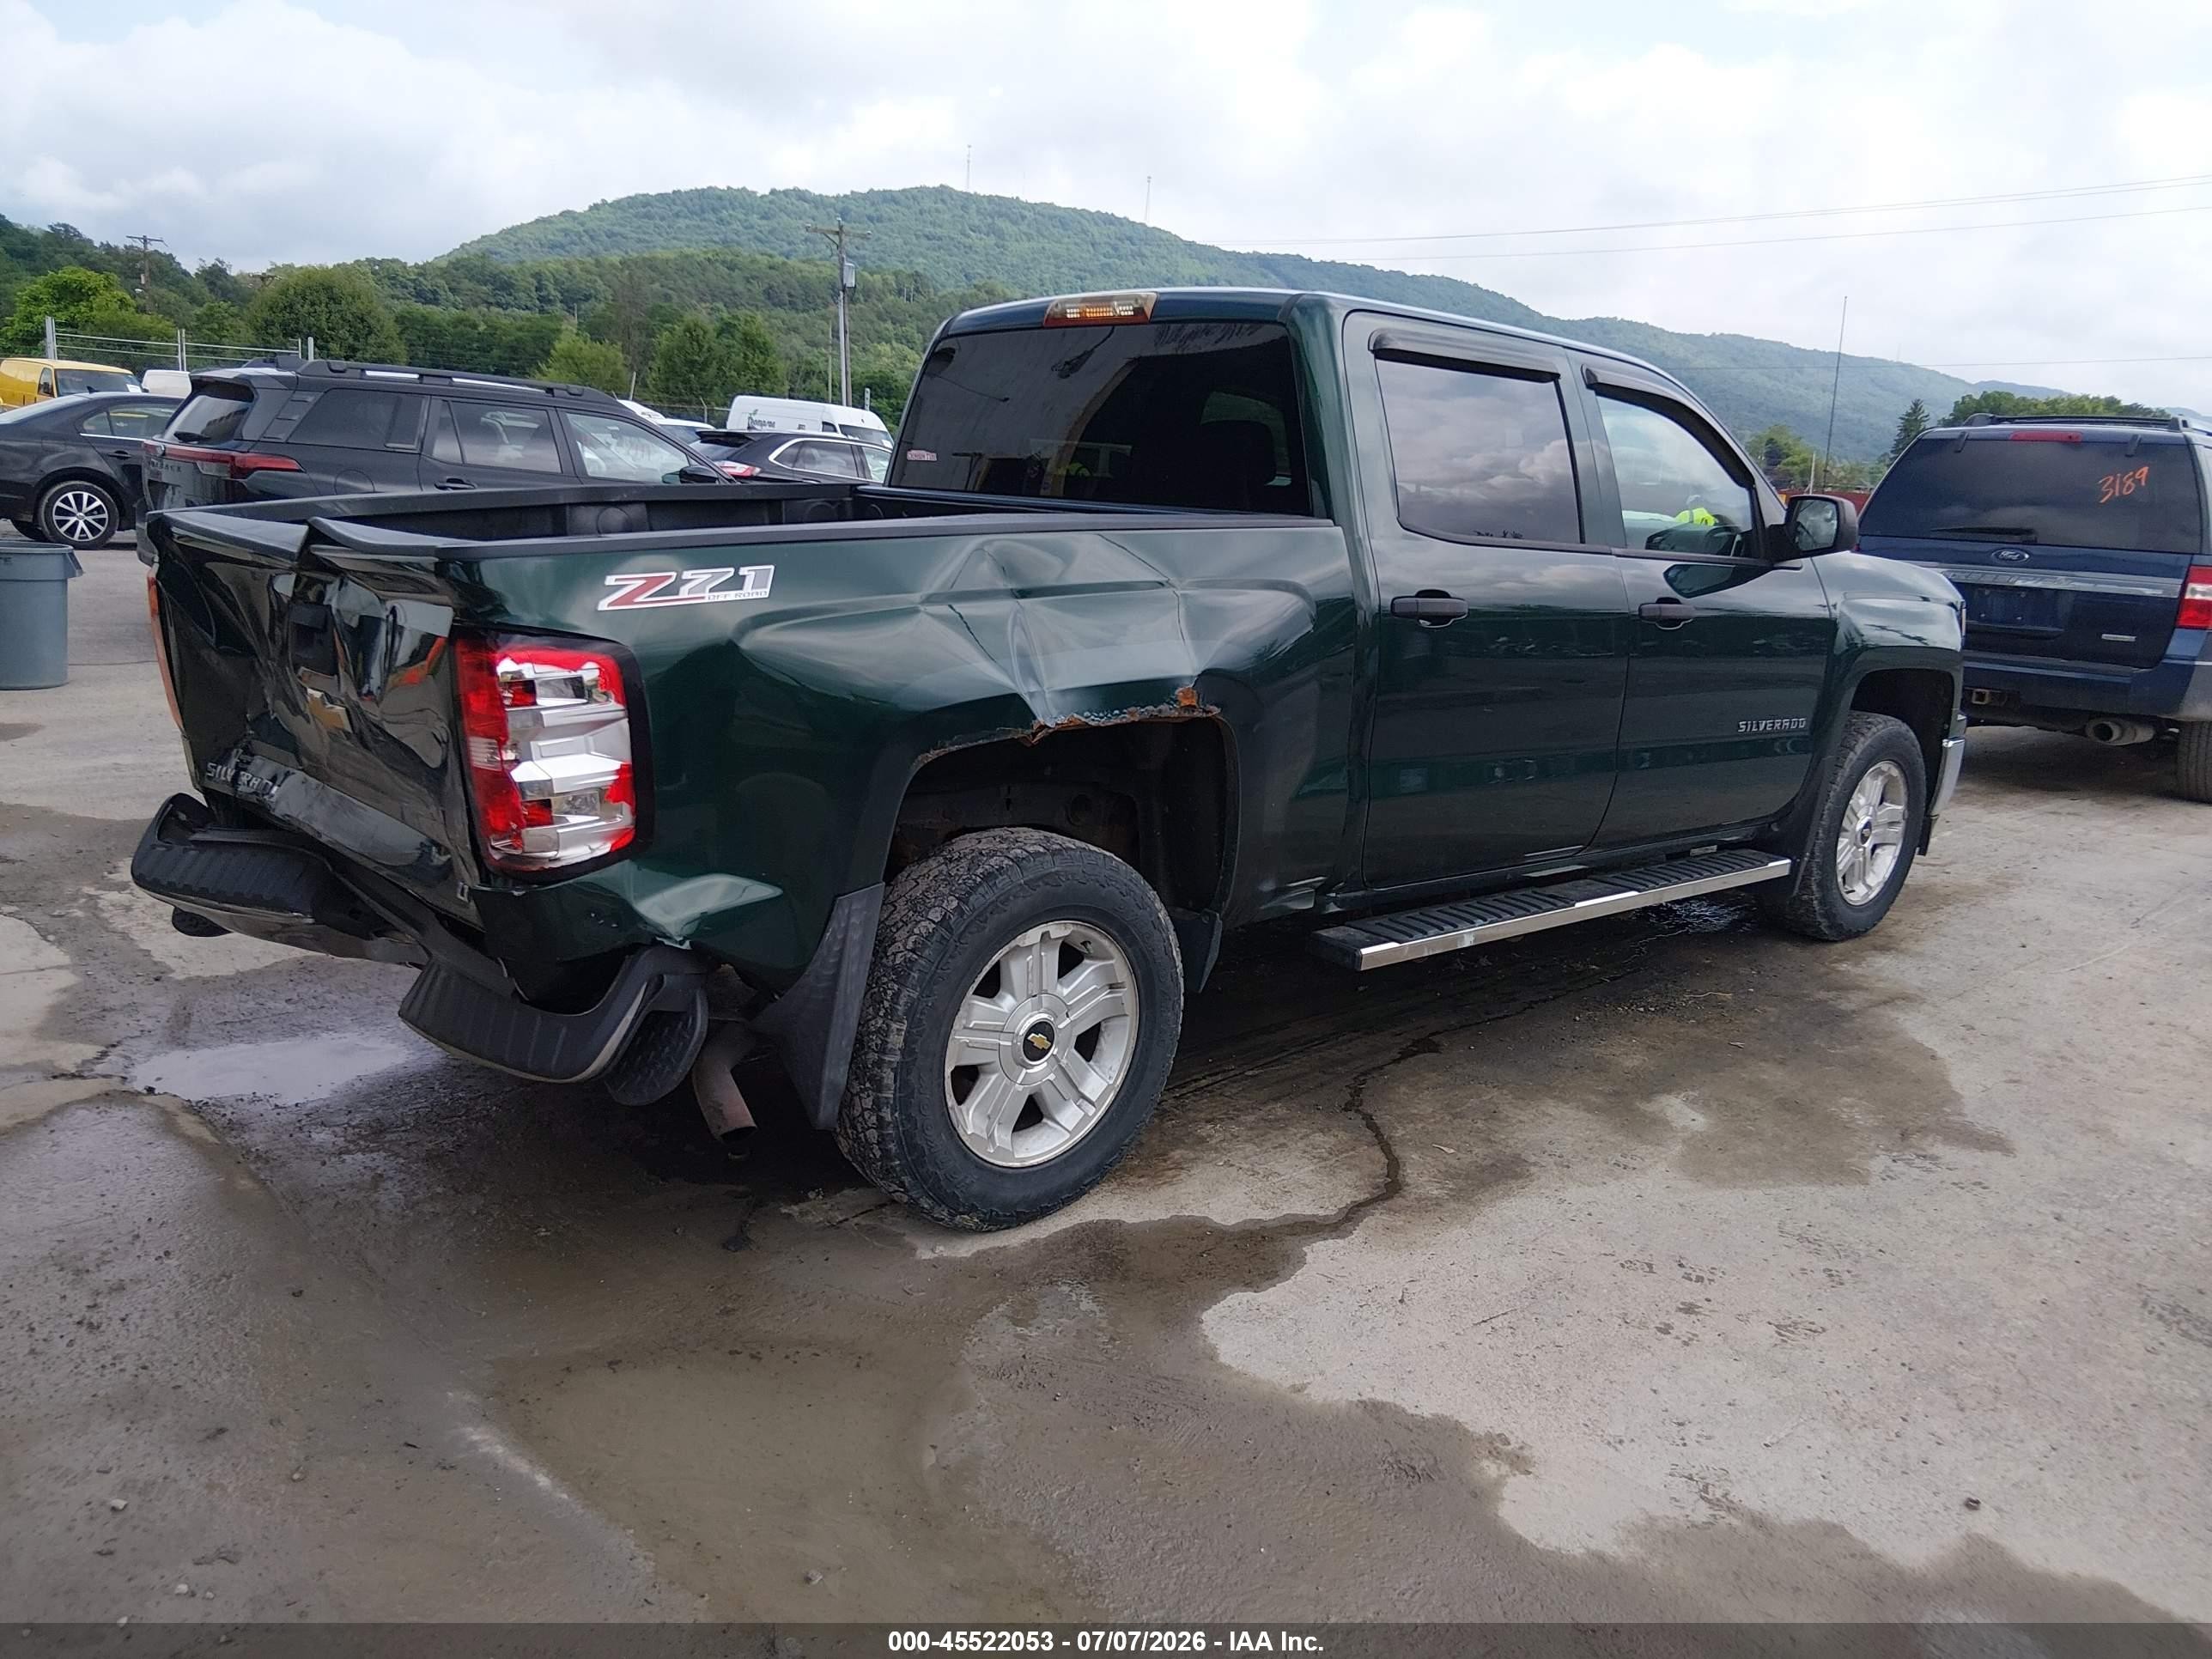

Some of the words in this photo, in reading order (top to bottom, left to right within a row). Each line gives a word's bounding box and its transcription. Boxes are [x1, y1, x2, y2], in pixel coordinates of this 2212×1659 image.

[2098, 466, 2150, 503] 3189
[597, 564, 775, 611] Z71
[1737, 718, 1808, 732] SILVERADO
